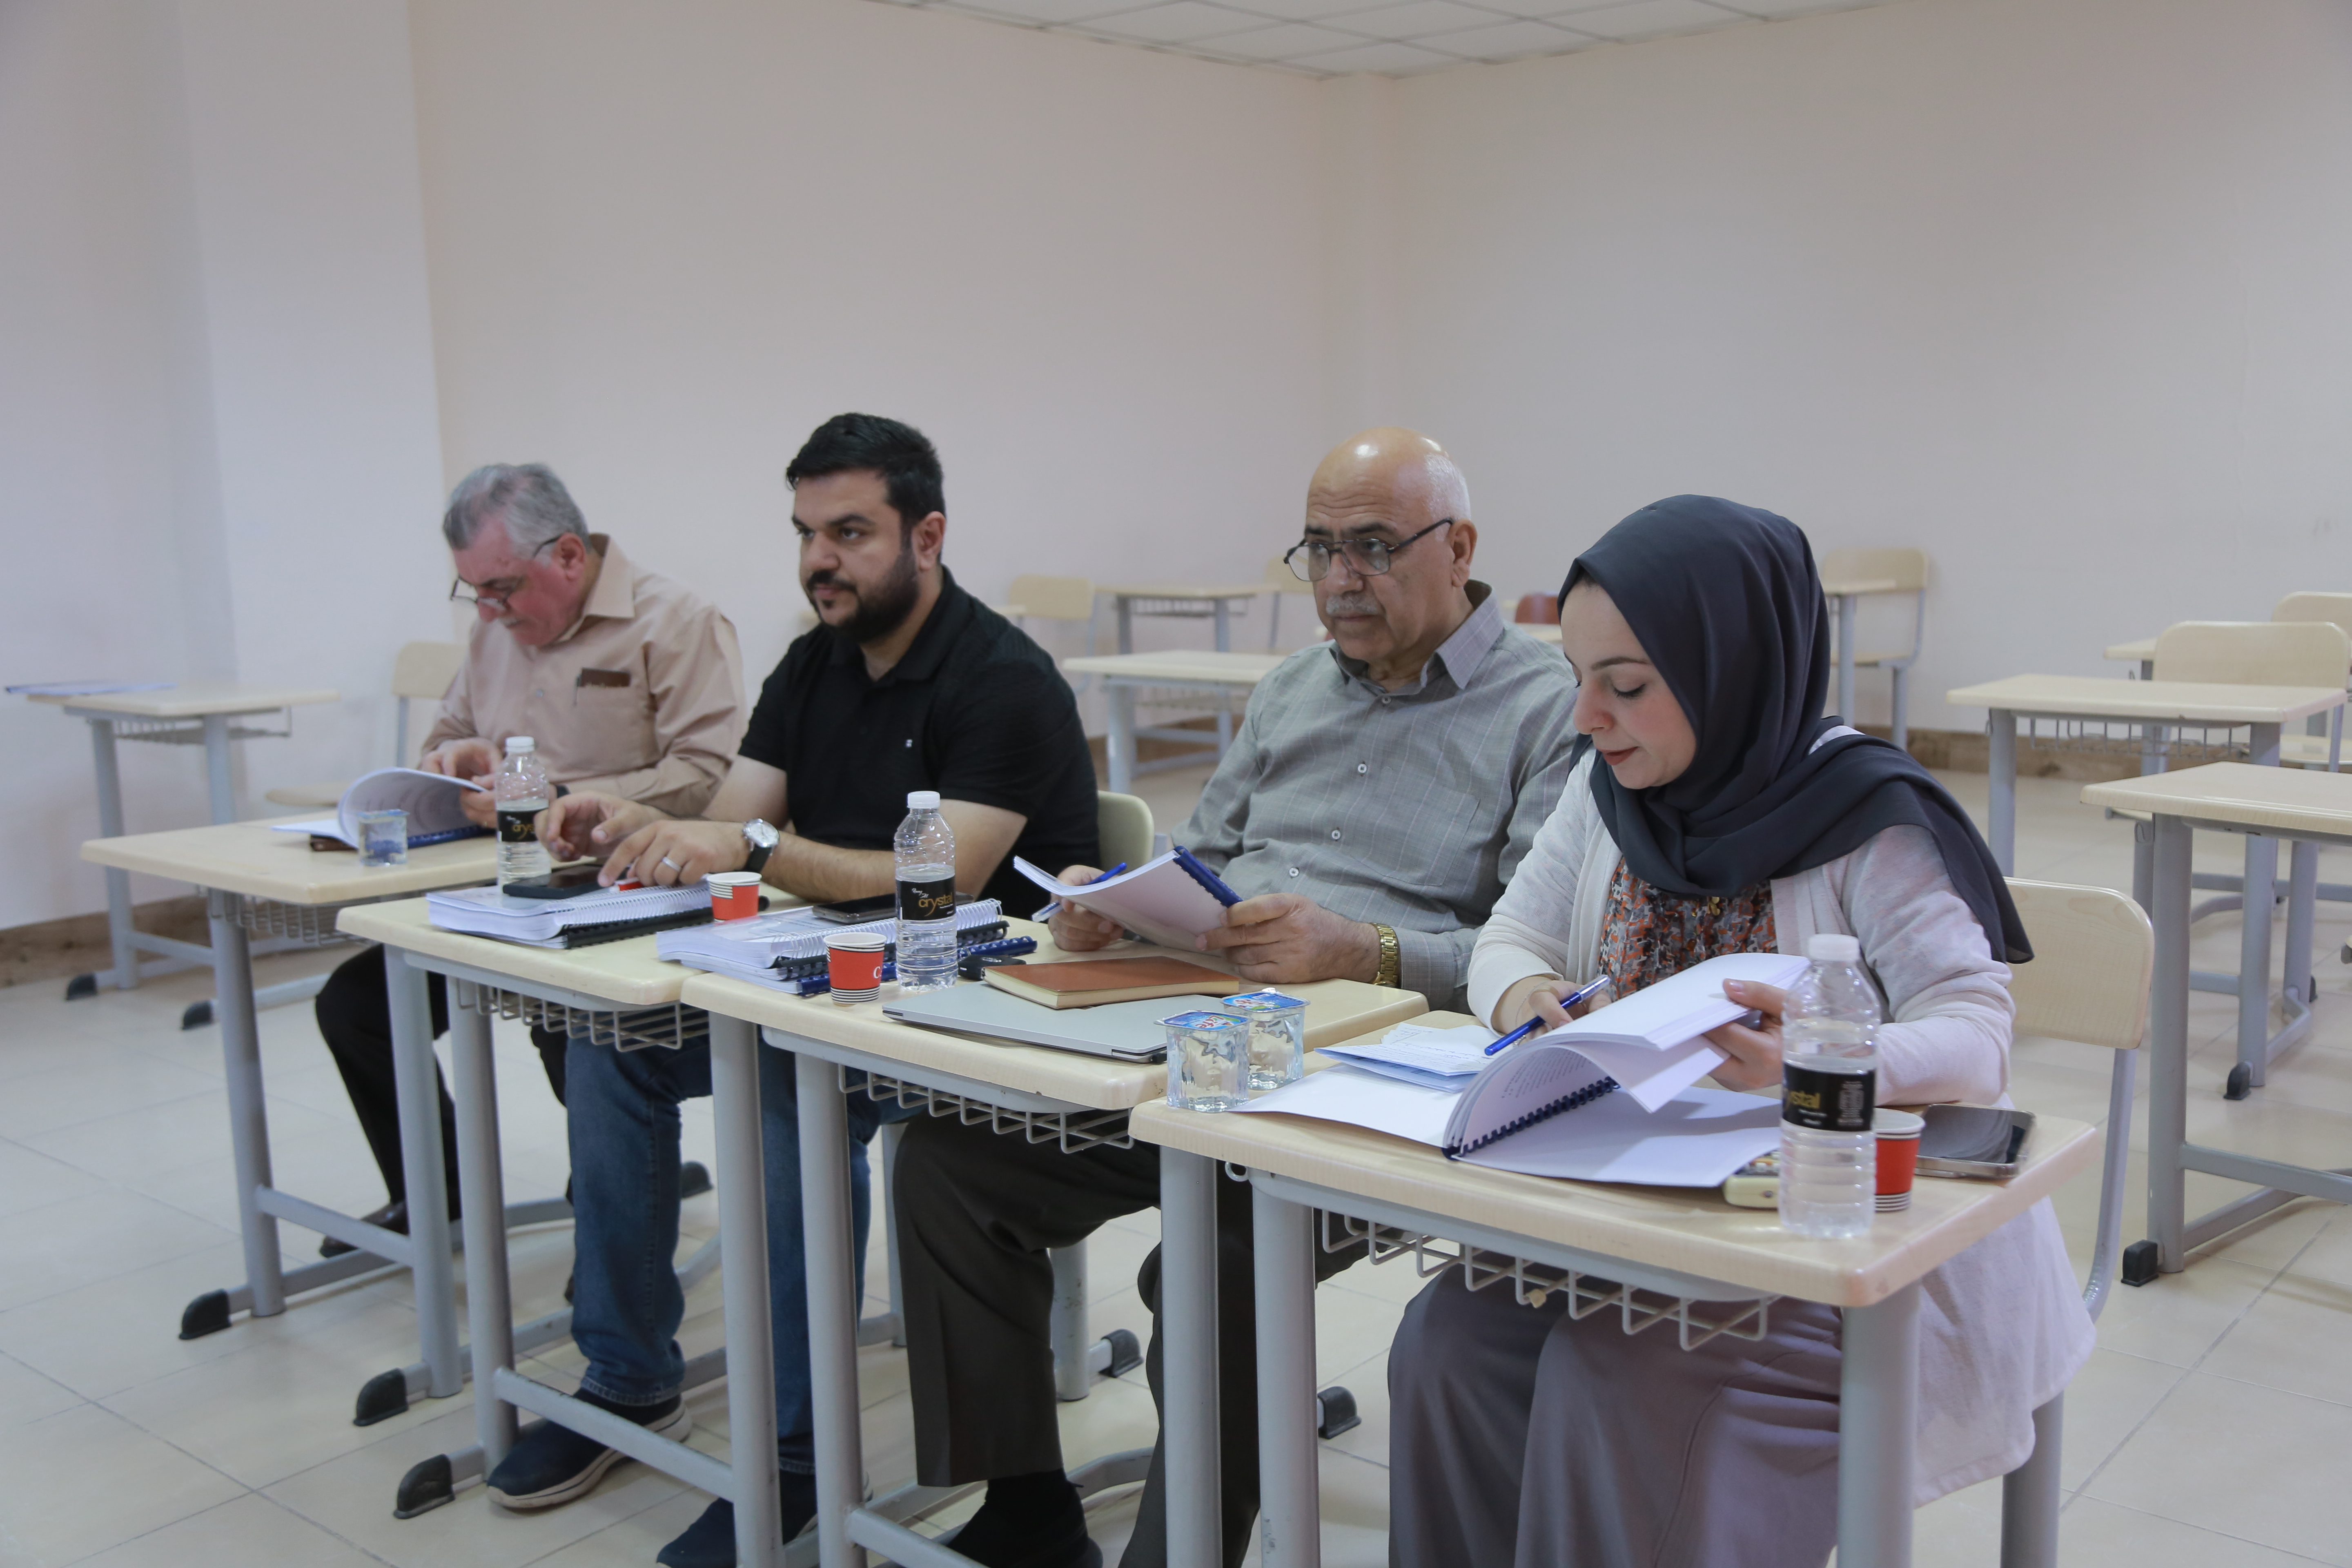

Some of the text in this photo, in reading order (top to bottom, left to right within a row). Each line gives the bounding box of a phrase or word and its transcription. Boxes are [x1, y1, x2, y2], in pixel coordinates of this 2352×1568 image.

[919, 892, 953, 917] crystal
[873, 966, 882, 979] C
[1195, 1015, 1224, 1028] Life
